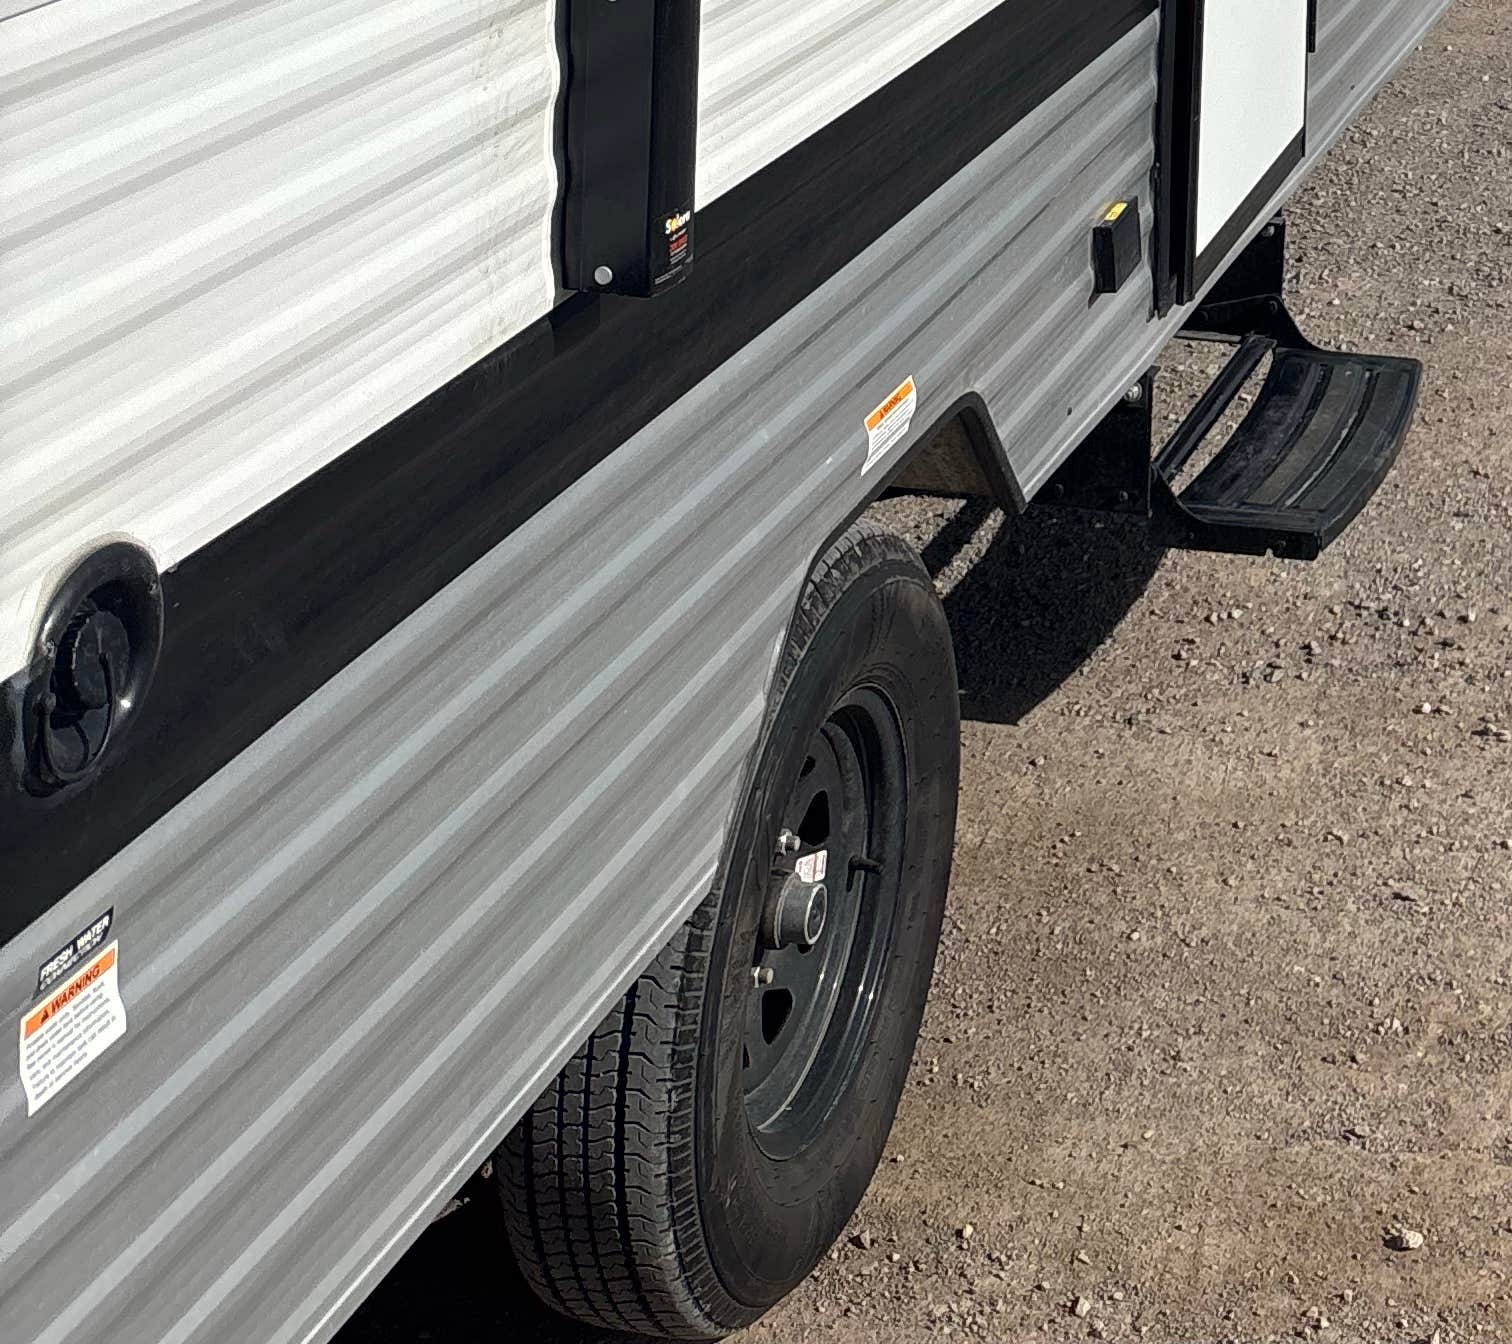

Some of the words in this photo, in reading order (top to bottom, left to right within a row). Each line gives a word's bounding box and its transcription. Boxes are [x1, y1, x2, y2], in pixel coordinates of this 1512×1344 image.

[40, 944, 74, 981] FRESH
[77, 915, 110, 950] WATER
[51, 964, 101, 1014] WARNING
